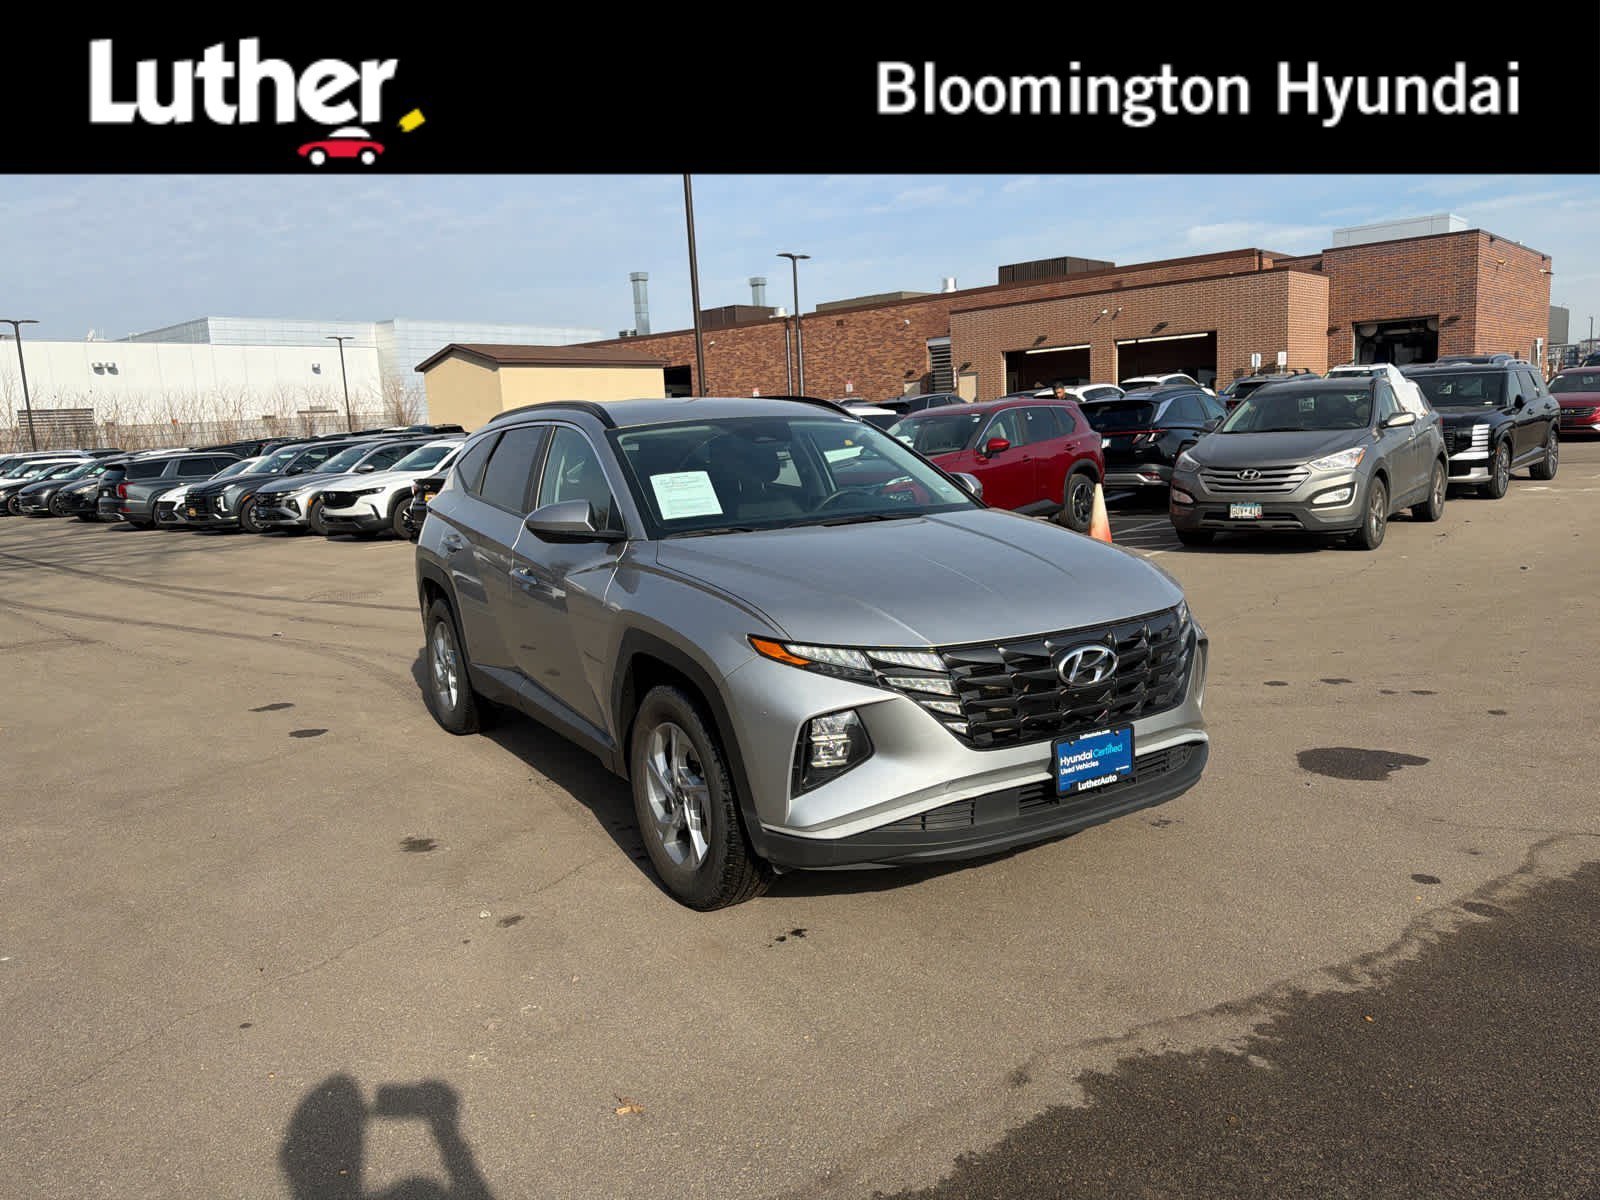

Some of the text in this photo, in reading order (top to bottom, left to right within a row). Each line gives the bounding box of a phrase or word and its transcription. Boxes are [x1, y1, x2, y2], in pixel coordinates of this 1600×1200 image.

[1060, 743, 1122, 766] Hyundai Certified
[1060, 760, 1099, 775] Used Vehicles
[1078, 774, 1118, 791] LutherAuto
